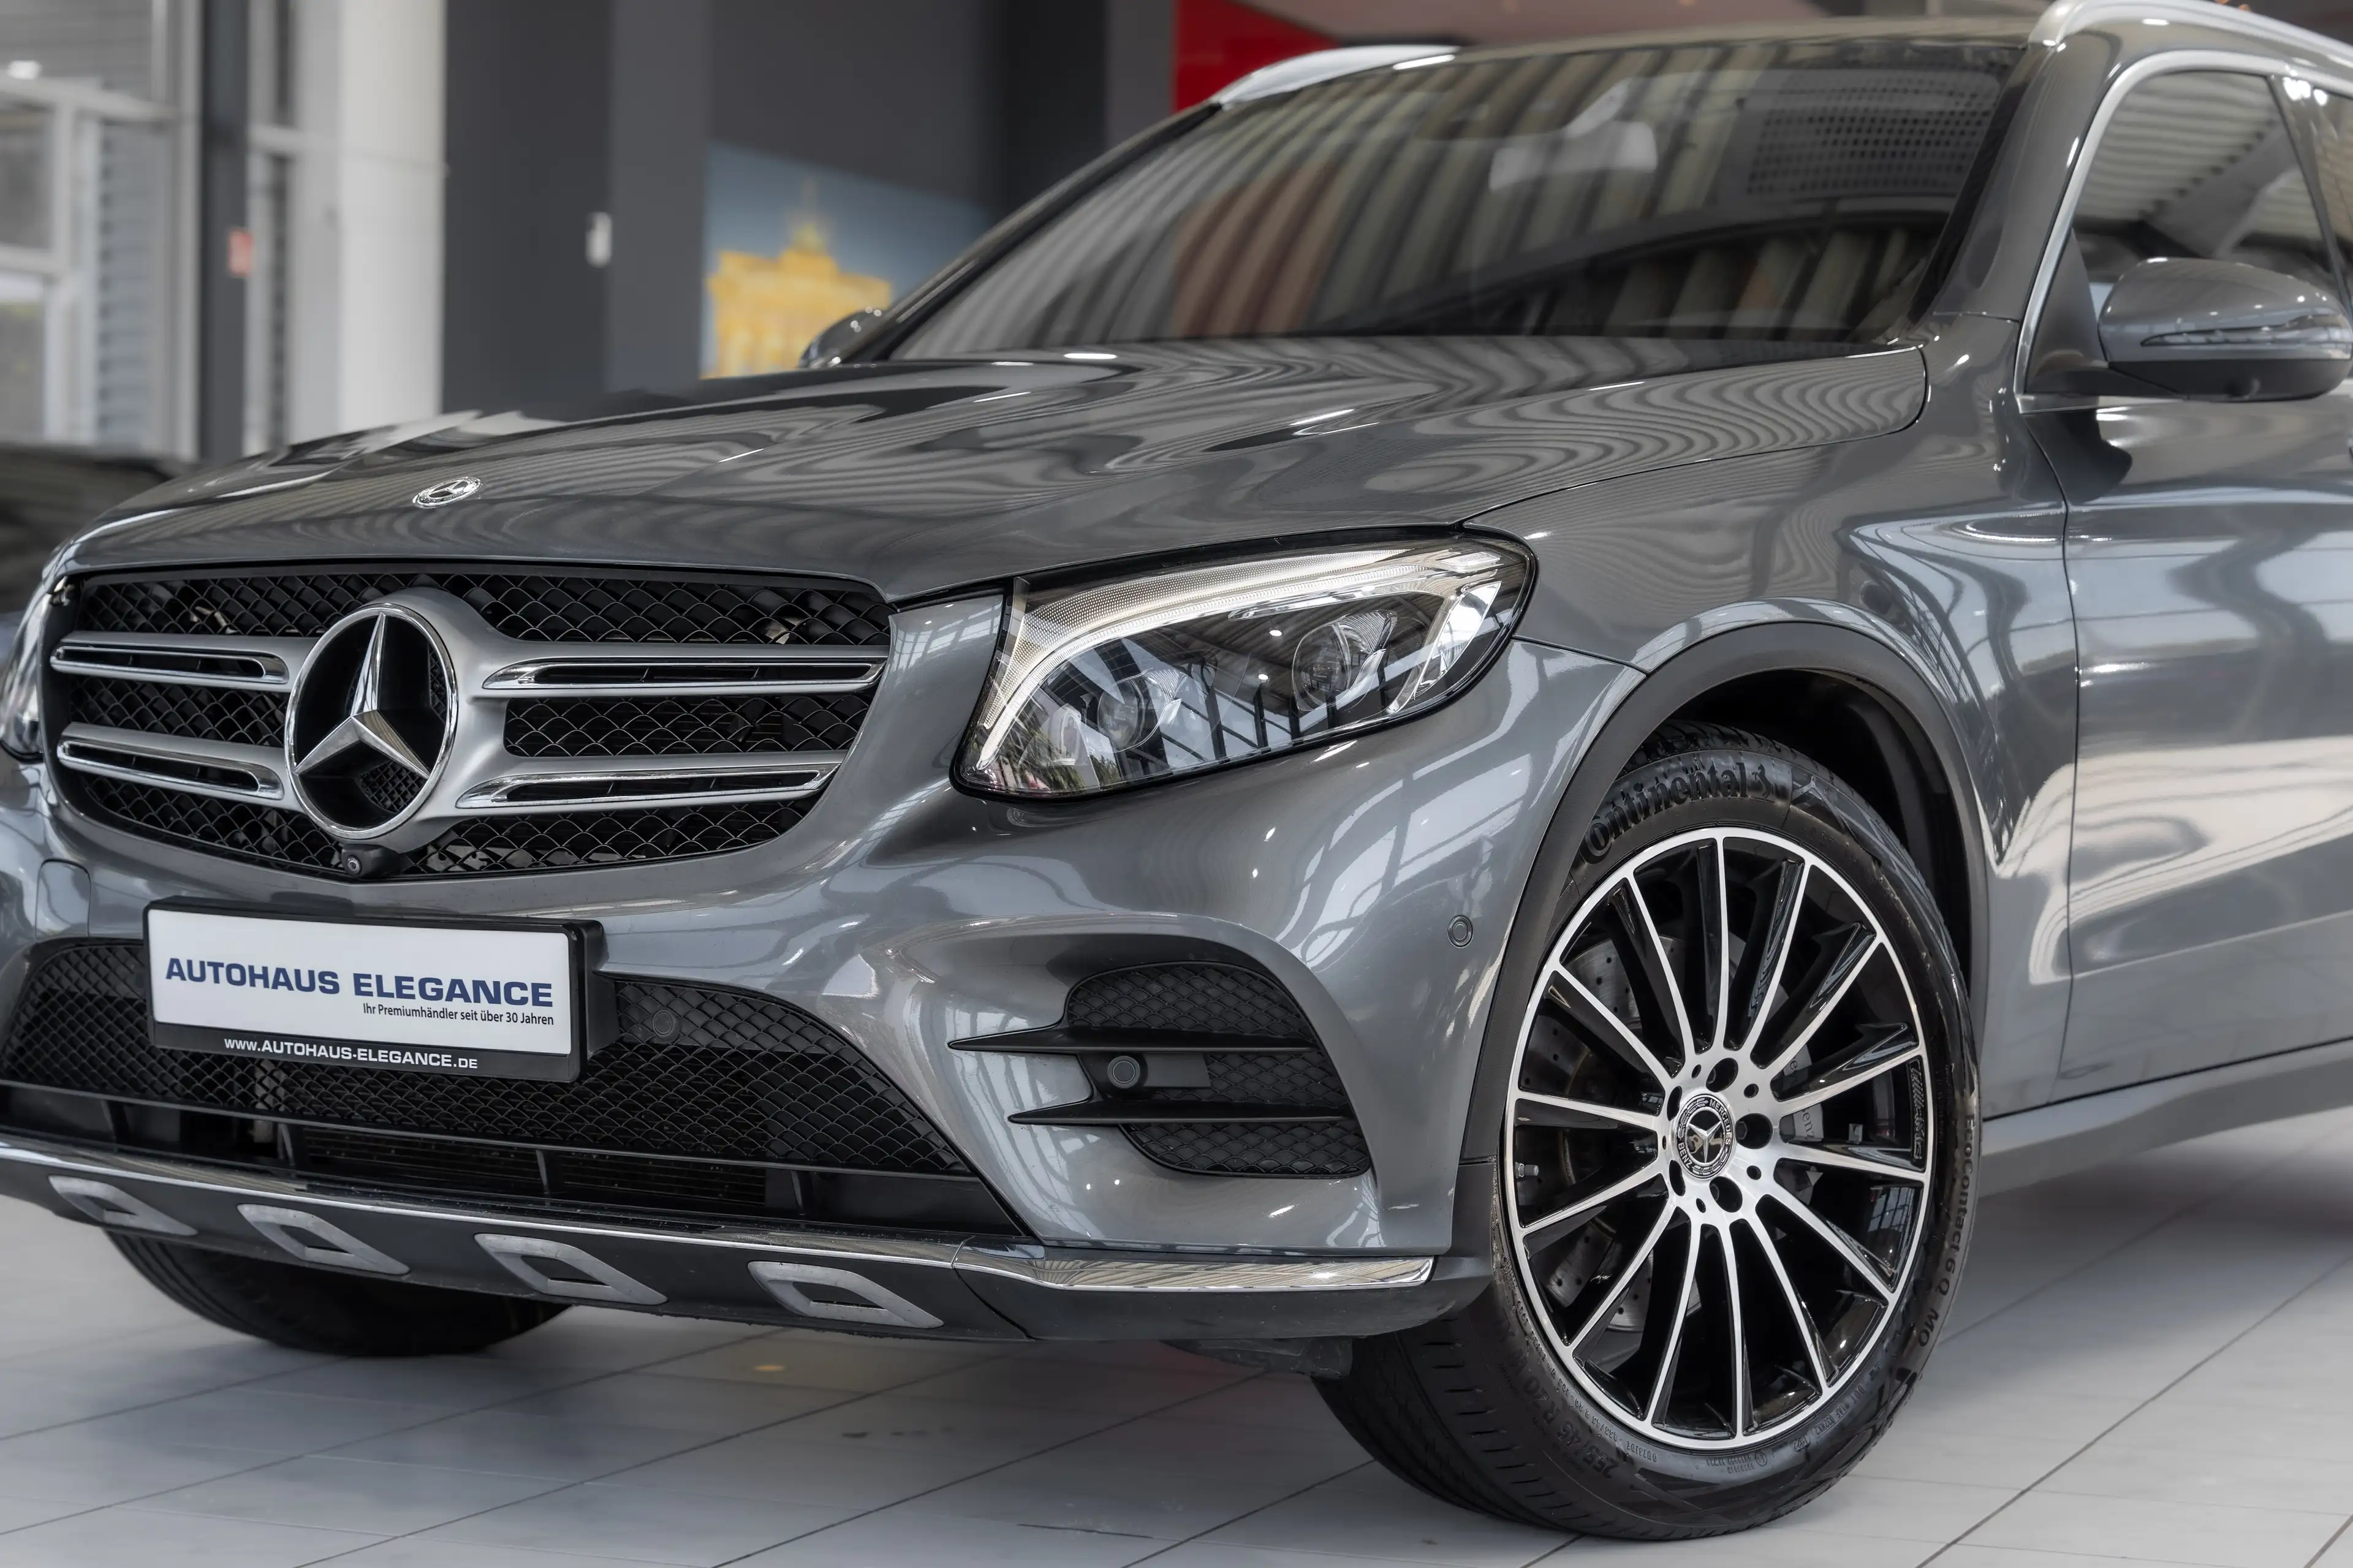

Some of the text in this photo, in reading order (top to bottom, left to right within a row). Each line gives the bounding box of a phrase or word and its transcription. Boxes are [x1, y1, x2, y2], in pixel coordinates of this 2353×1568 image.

[165, 958, 553, 1007] AUTOHAUS ELEGANCE
[363, 1002, 554, 1026] Ihr Premiumhändler seit über 30 Jahren
[224, 1037, 478, 1069] www.AUTOHAUS-ELEGANCE.DE
[1708, 1099, 1733, 1145] MERCEDES
[1678, 1142, 1693, 1168] BENZ
[1949, 1115, 1976, 1251] EcoContact
[1945, 1258, 1955, 1274] 6
[1918, 1307, 1939, 1347] MO
